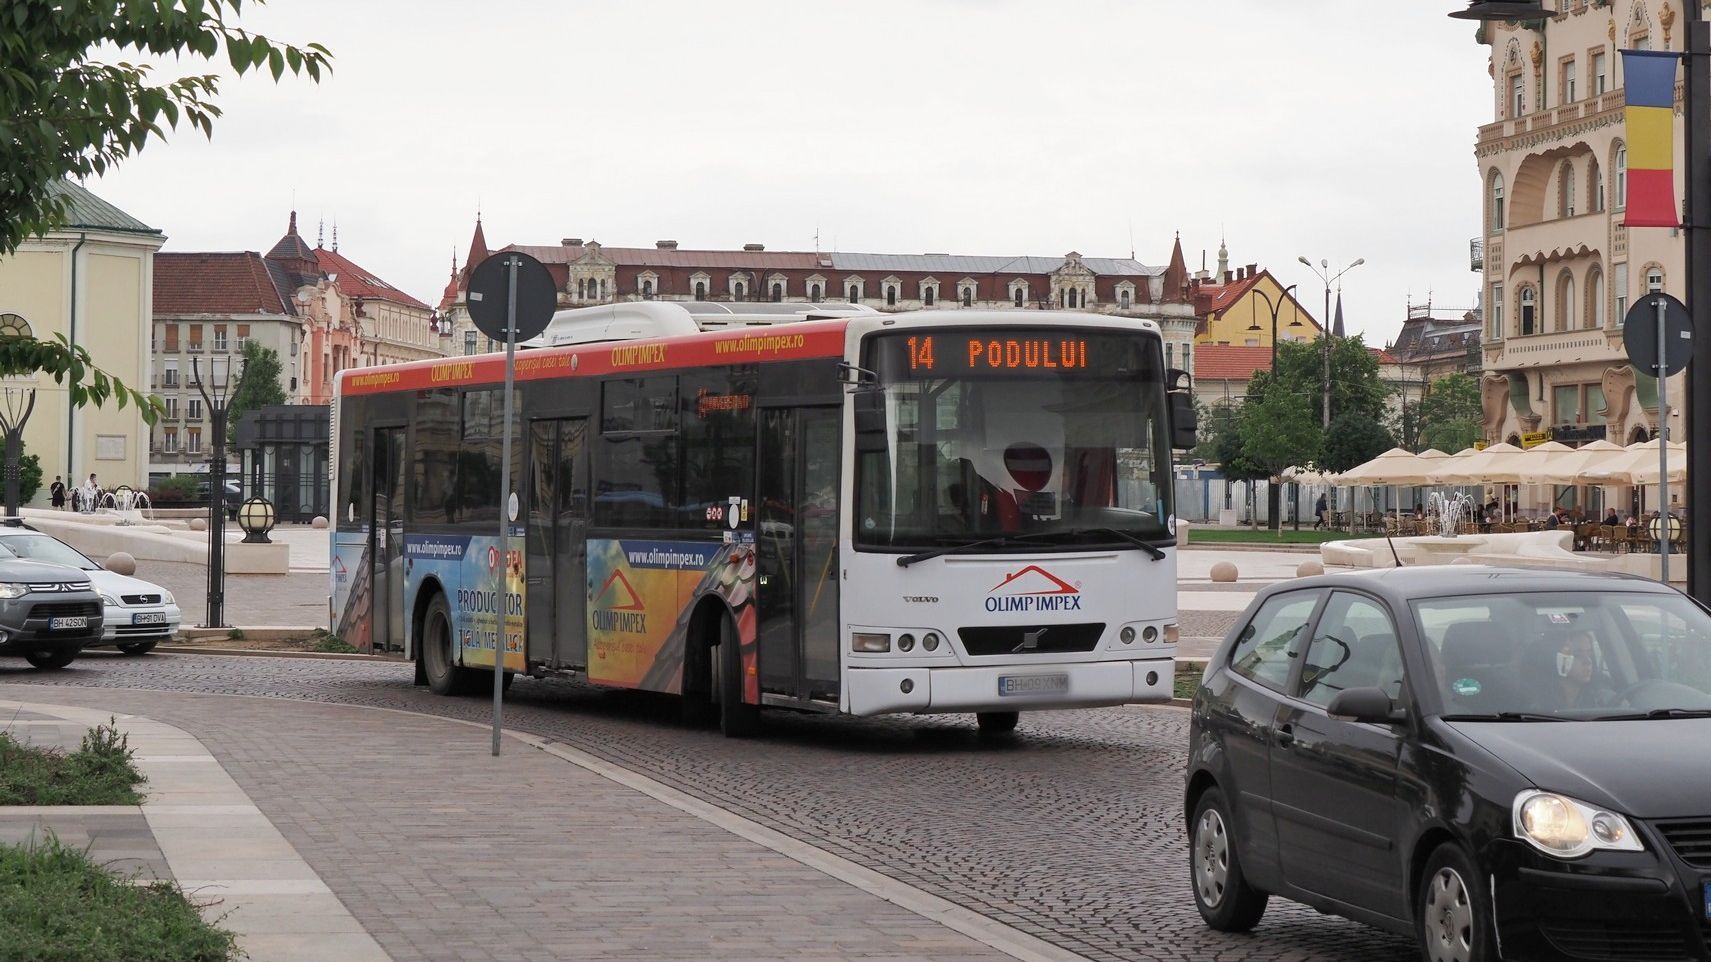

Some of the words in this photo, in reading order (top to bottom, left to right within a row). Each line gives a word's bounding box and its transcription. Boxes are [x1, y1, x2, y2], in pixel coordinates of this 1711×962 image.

[715, 332, 804, 355] www.olimpimpex.ro
[908, 336, 934, 369] 14
[968, 340, 1086, 368] PODULUI
[351, 371, 400, 387] www.olimpimpex.ro
[406, 541, 462, 558] www.olimpimpex.ro
[628, 547, 704, 568] www.olimpimpex.ro
